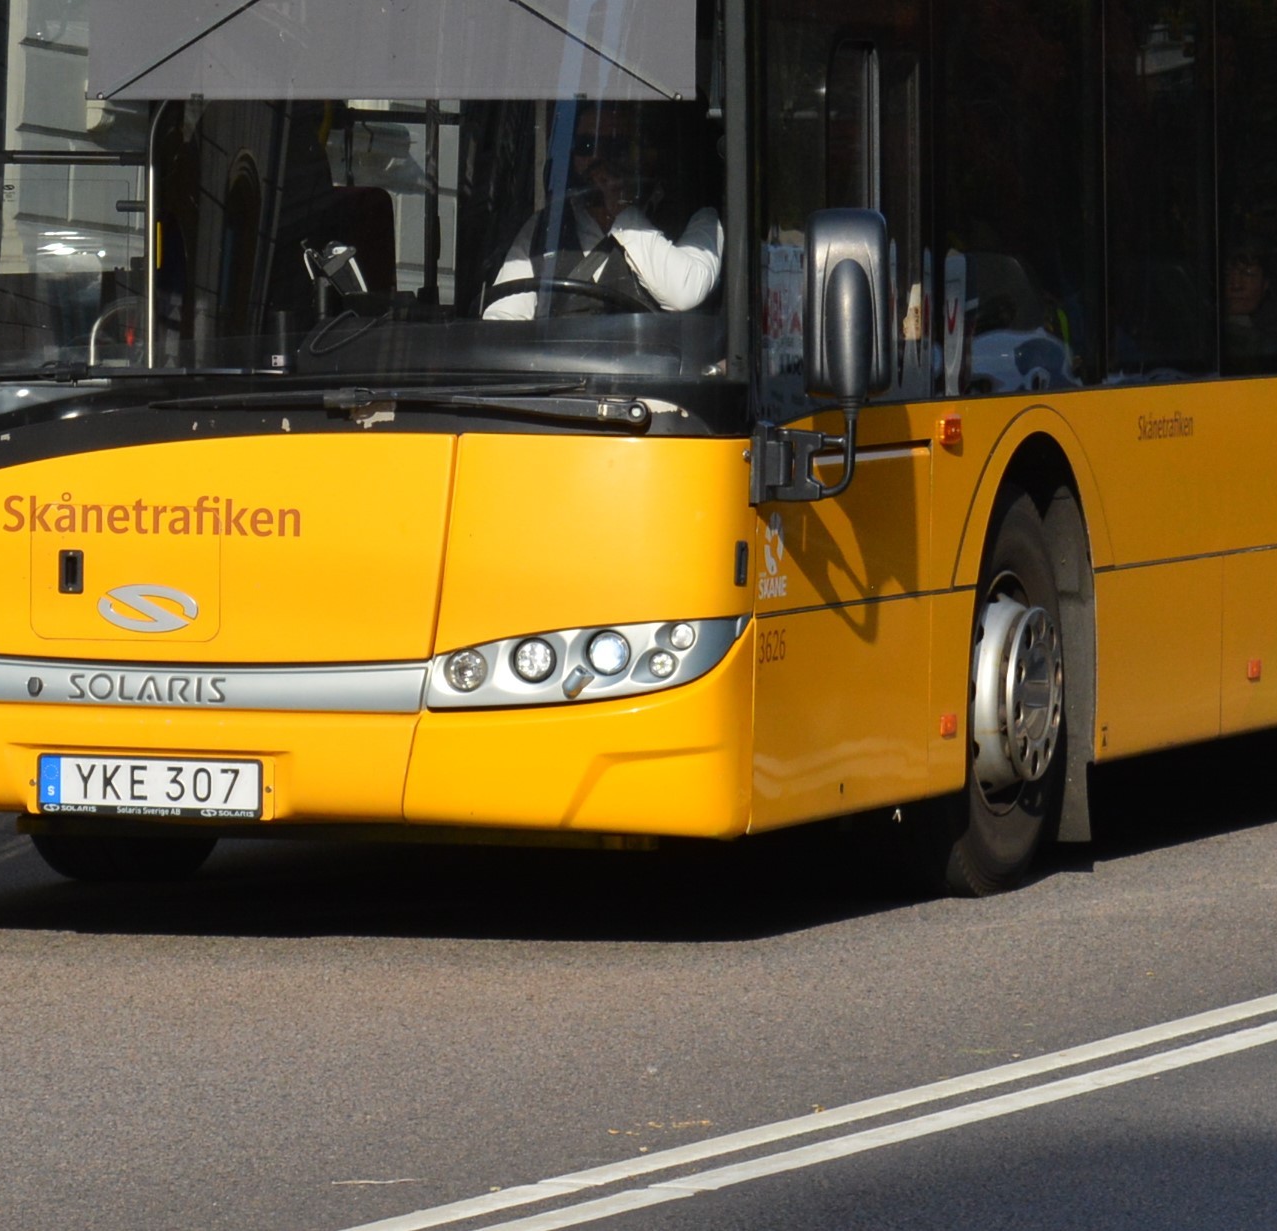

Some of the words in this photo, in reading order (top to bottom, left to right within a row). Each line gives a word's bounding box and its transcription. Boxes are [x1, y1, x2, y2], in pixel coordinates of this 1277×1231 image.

[1137, 410, 1194, 441] Skånetrafiken
[2, 491, 302, 537] Skånetrafiken
[758, 629, 786, 664] 3626
[67, 672, 227, 704] SOLARIS
[47, 785, 56, 796] S
[75, 763, 148, 800] YKE
[165, 766, 240, 804] 307
[60, 804, 97, 813] SOLARIS
[116, 805, 142, 815] Solaris
[142, 806, 170, 817] Sverige
[170, 808, 182, 816] AB
[218, 810, 255, 818] SOLARIS
